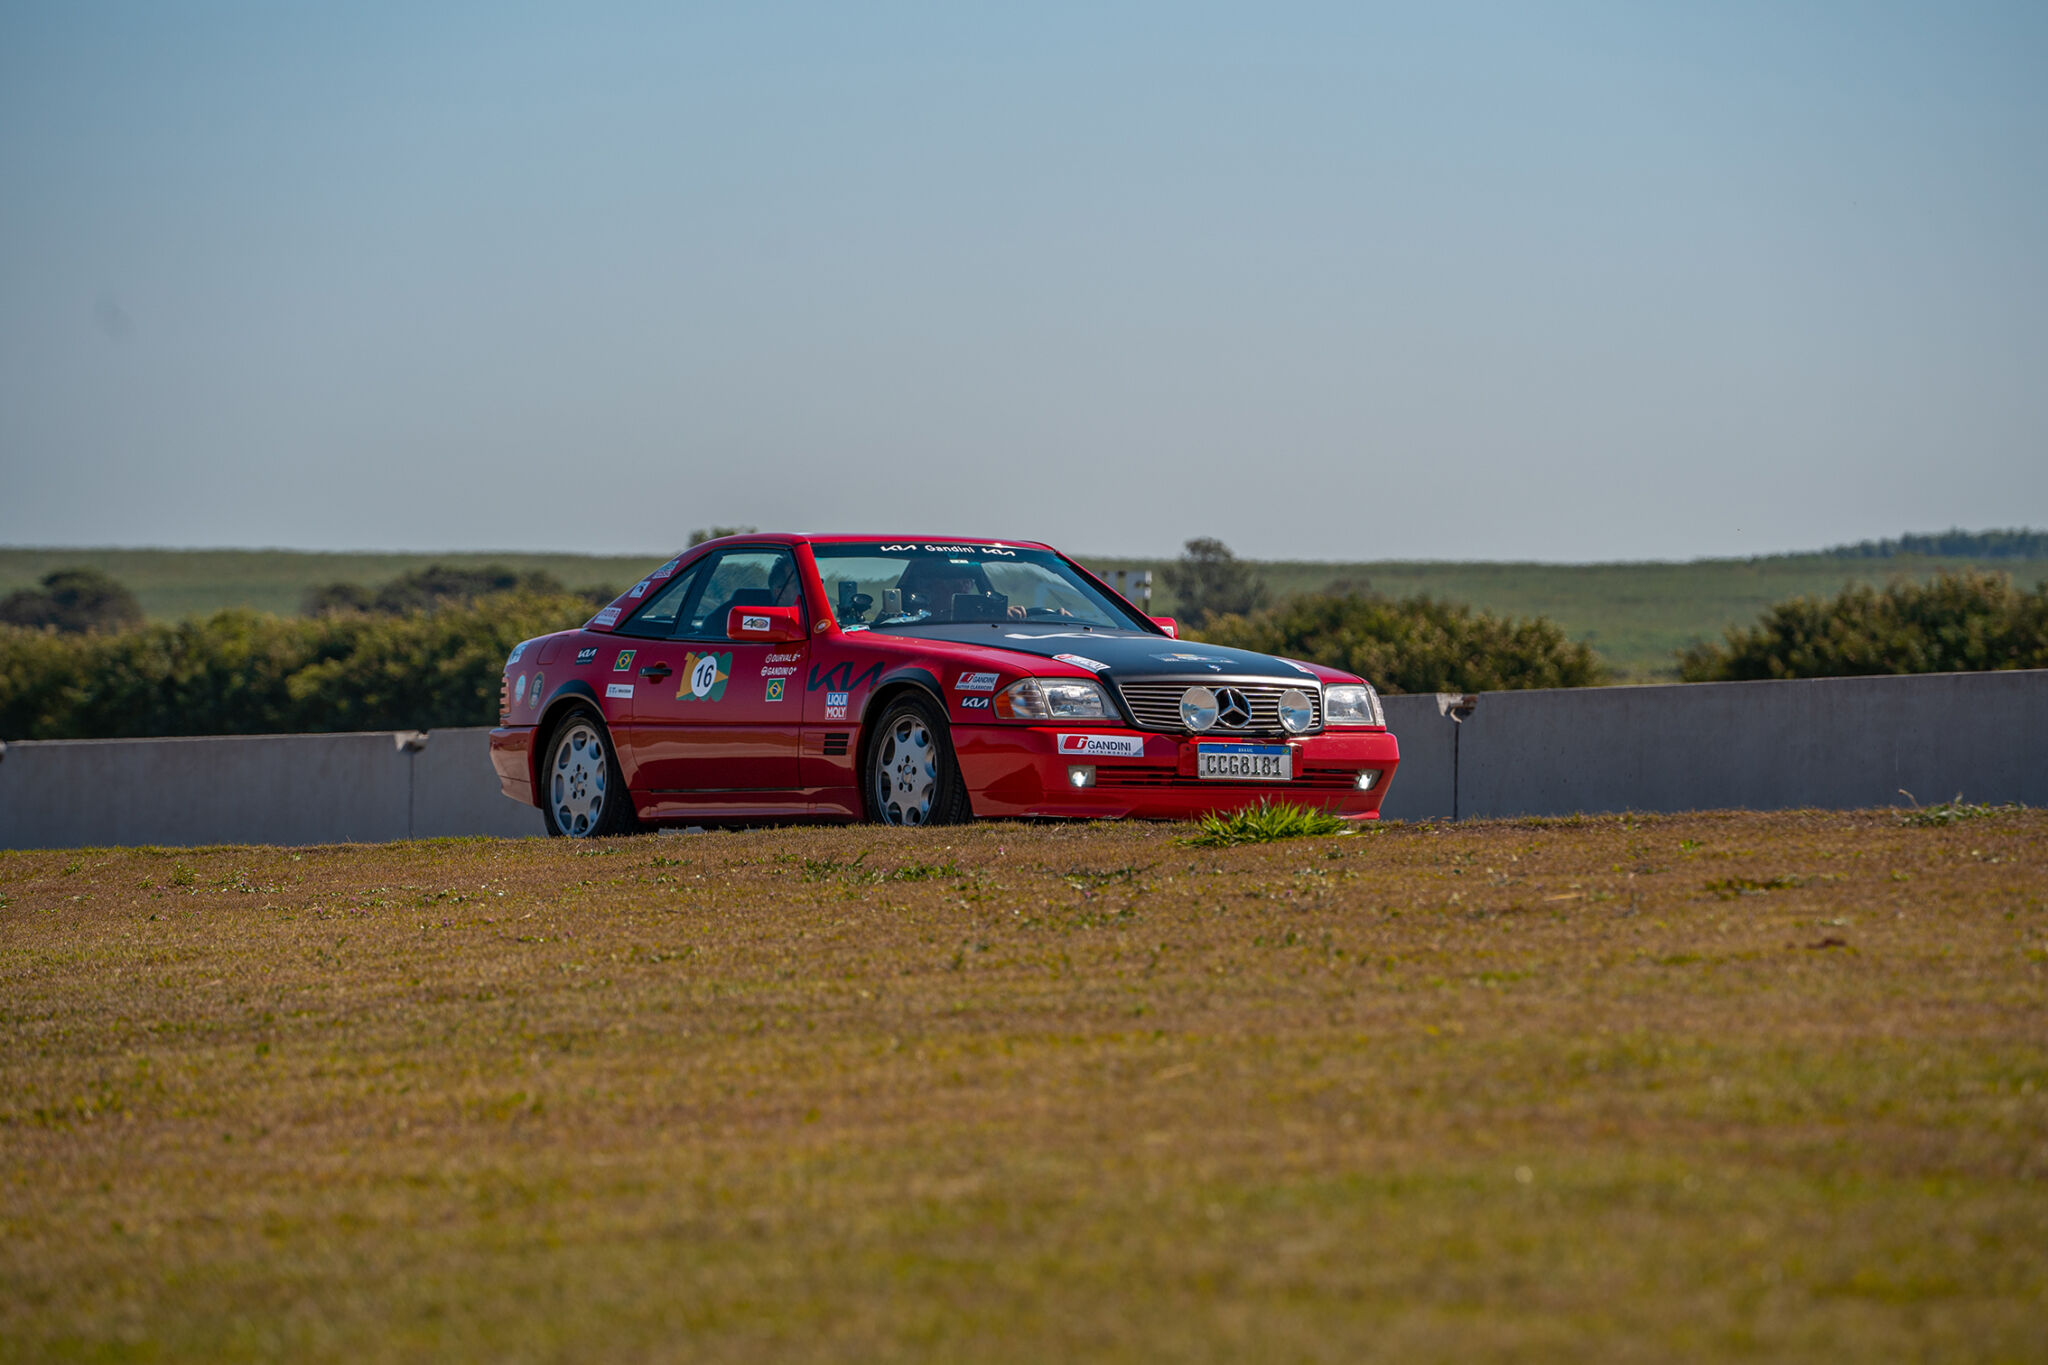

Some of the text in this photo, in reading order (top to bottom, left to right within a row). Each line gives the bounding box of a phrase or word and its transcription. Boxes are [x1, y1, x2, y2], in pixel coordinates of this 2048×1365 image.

[924, 545, 975, 553] Gandini
[697, 664, 714, 687] 16
[973, 676, 996, 684] GANDINI
[828, 695, 847, 706] LIQUI
[826, 707, 846, 718] MOLY
[1087, 740, 1131, 751] GANDINI
[1207, 756, 1281, 776] CCG8I81
